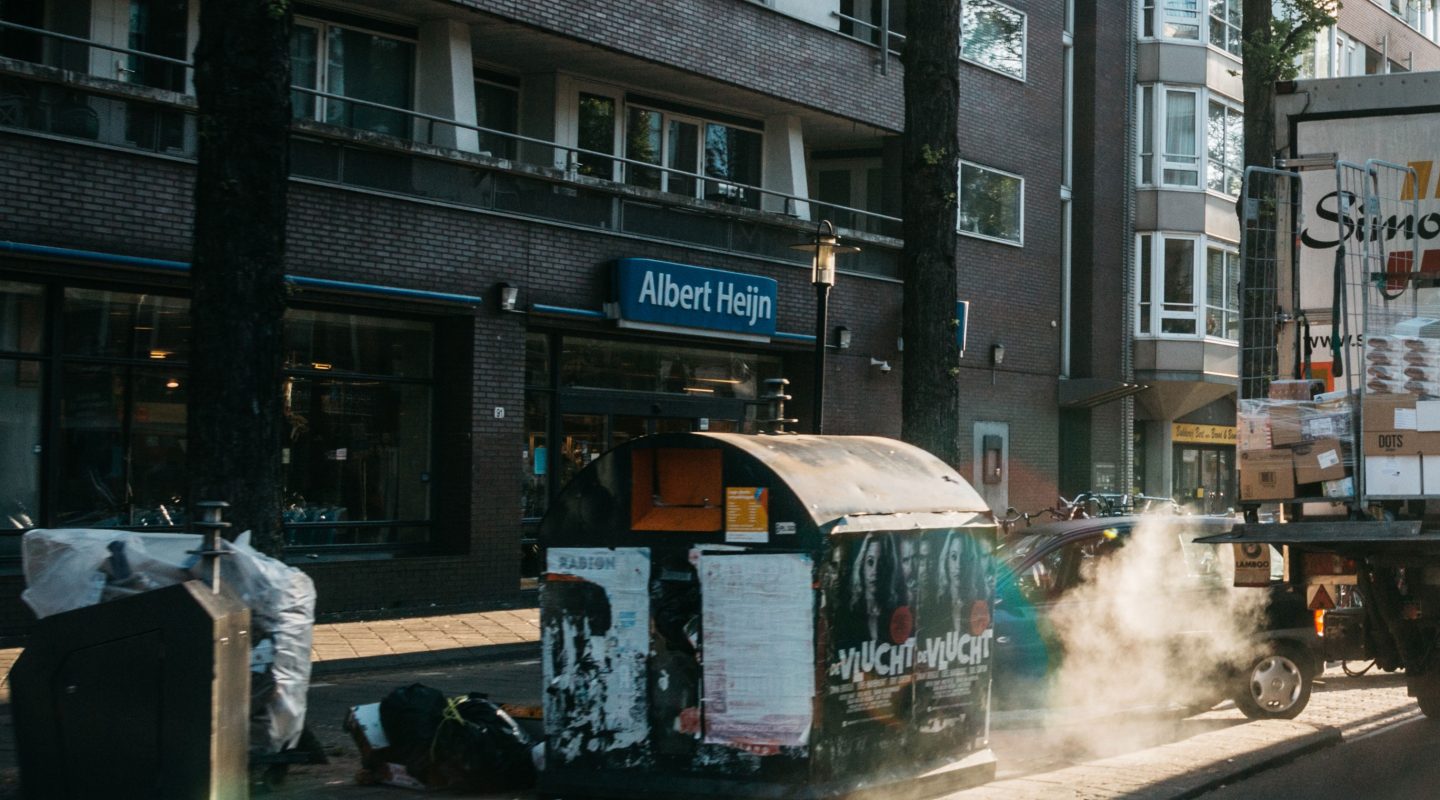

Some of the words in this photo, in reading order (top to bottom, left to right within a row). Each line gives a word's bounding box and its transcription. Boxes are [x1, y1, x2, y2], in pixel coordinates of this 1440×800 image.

[638, 270, 712, 312] Albert
[717, 281, 771, 326] Heijn
[1378, 434, 1403, 448] DOTS
[838, 637, 916, 683] VLUCHT
[926, 629, 993, 671] VLUCHT
